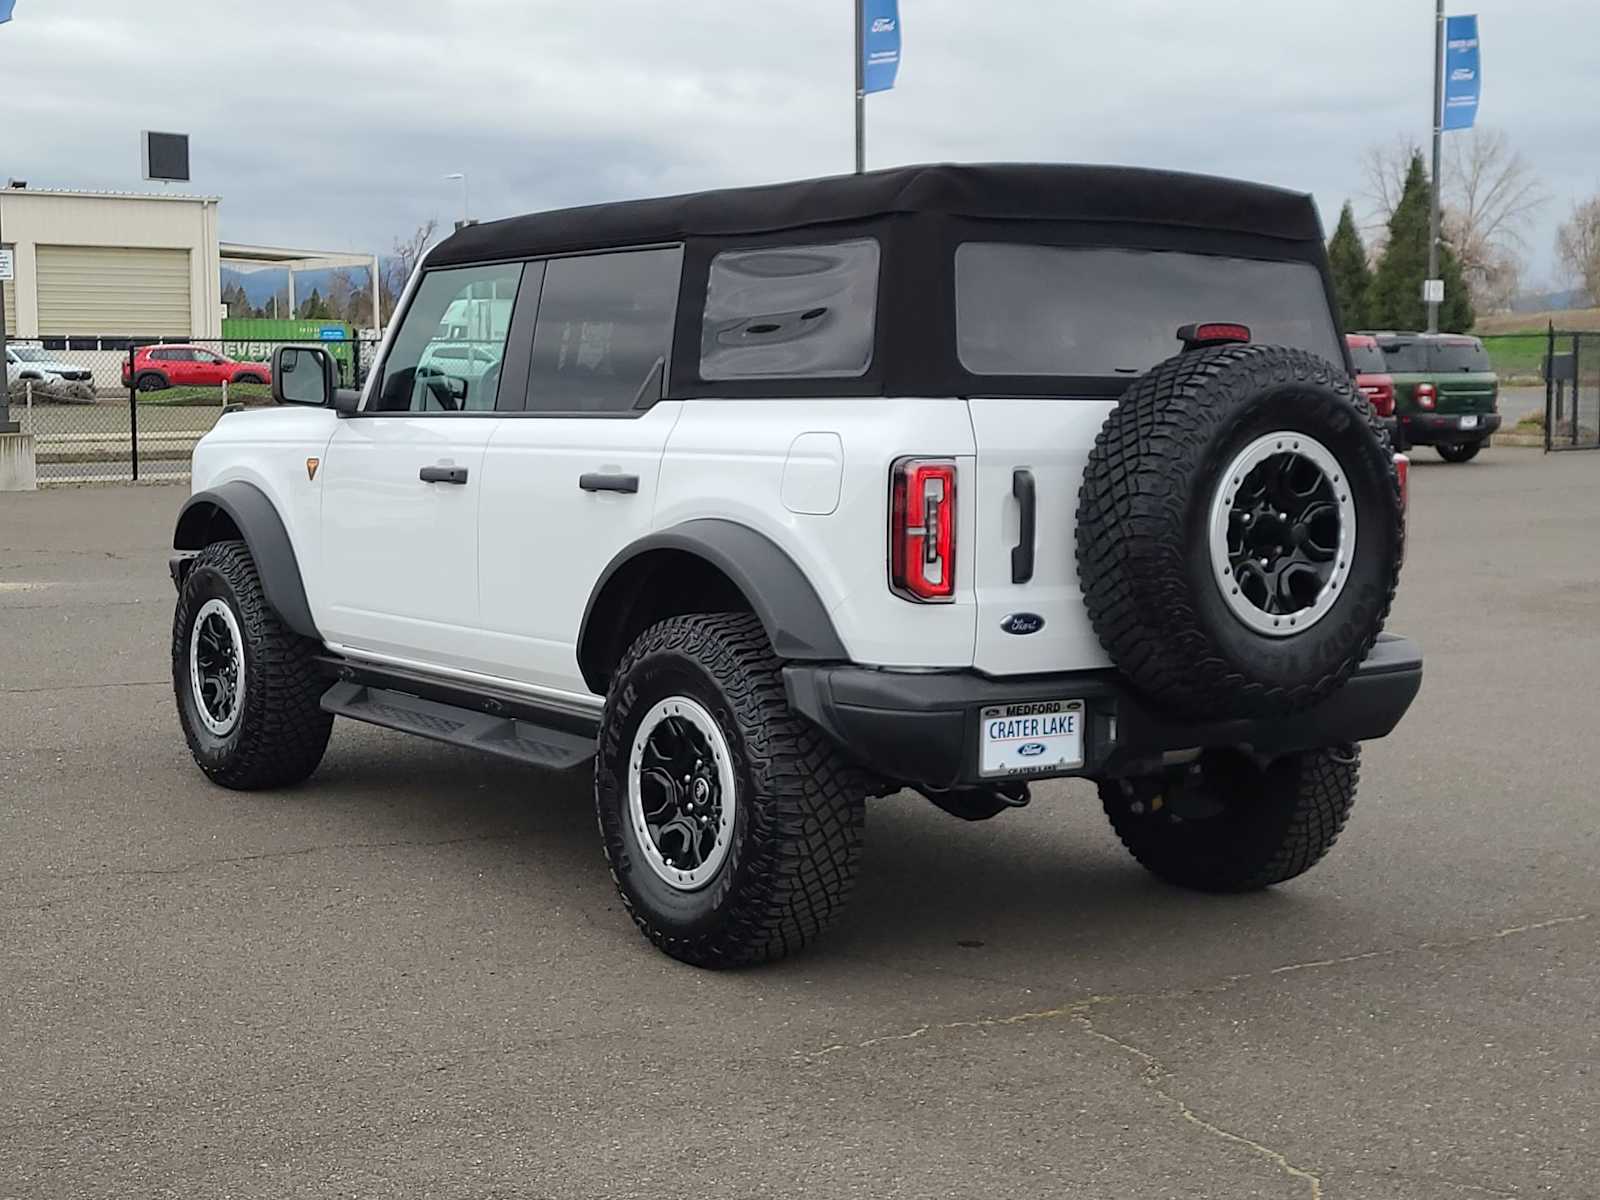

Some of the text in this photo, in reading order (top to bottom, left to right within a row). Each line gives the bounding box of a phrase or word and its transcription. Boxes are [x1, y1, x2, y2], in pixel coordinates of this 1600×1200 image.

[1009, 616, 1038, 631] Ford
[1006, 703, 1061, 717] MEDFORD
[990, 716, 1074, 739] CRATER LAKE
